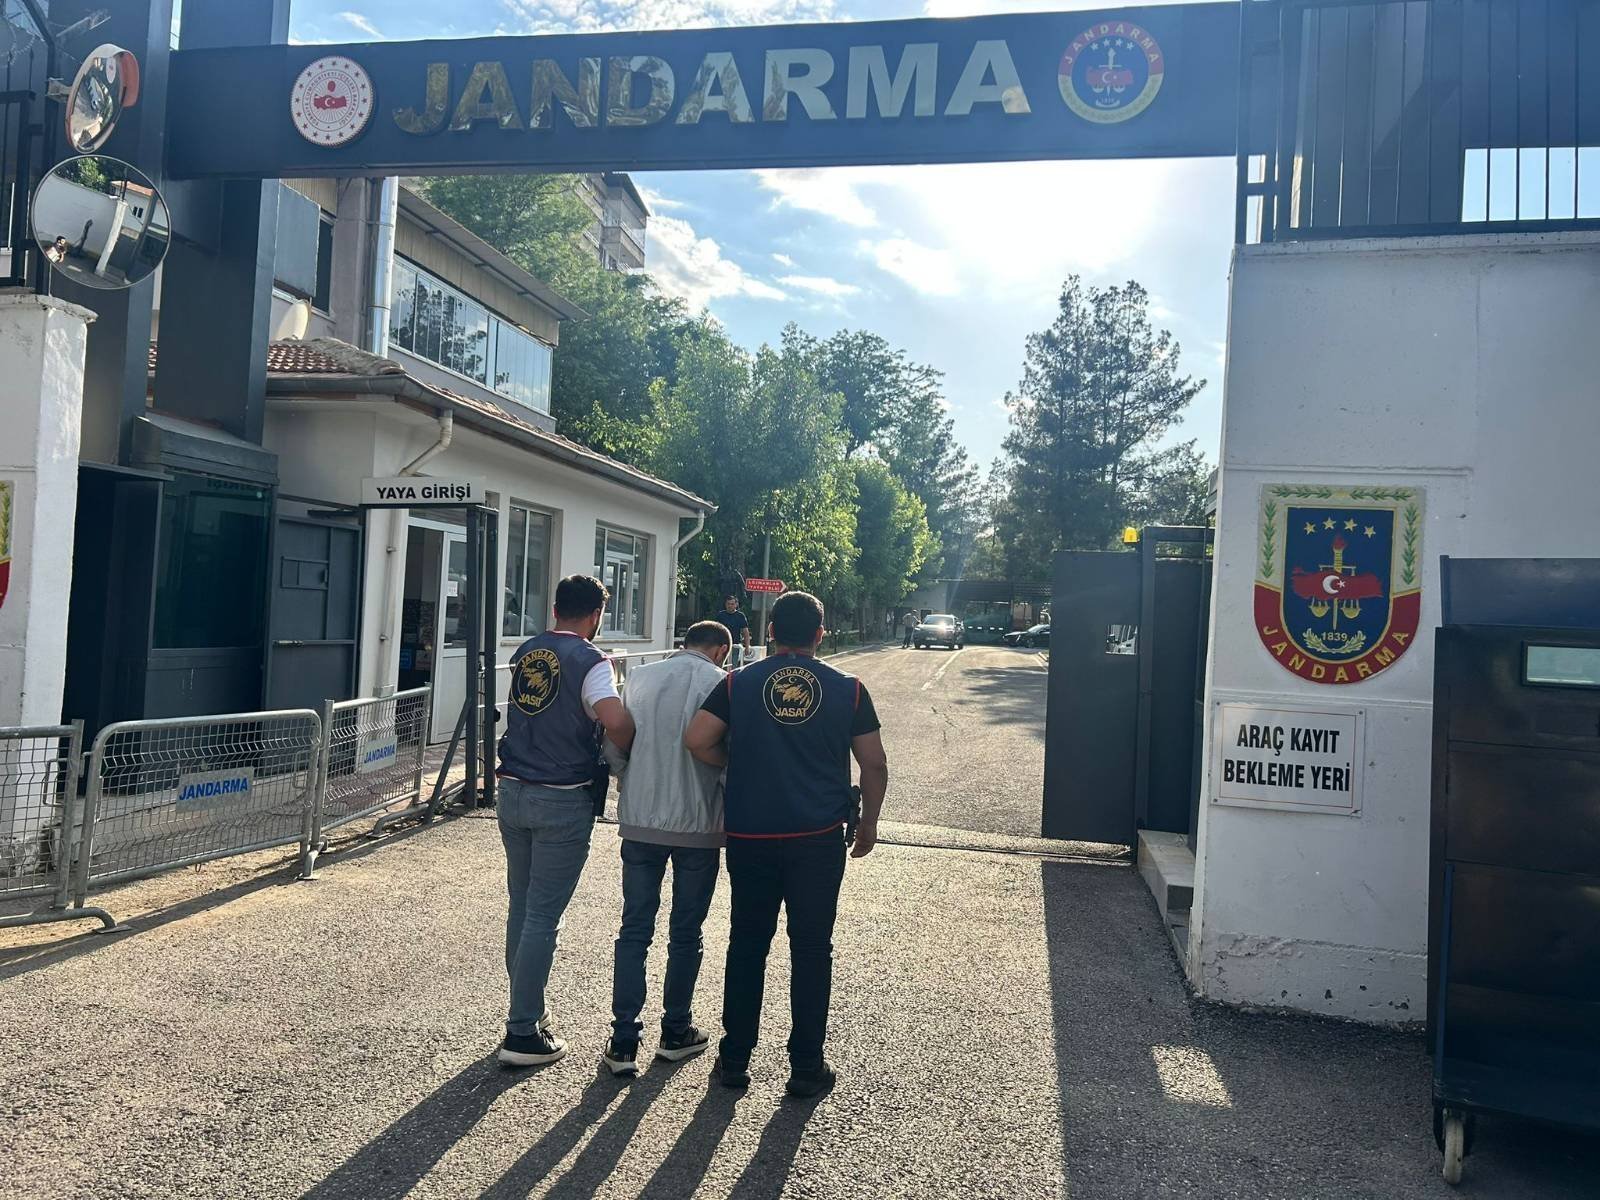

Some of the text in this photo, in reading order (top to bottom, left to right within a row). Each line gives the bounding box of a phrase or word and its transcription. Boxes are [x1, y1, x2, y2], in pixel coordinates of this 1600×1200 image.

[1064, 23, 1160, 65] JANDARMA
[391, 39, 1032, 135] JANDARMA
[376, 482, 471, 501] YAYA GİRİŞİ
[1321, 631, 1348, 642] 1839
[521, 650, 559, 677] JANDARMA
[1262, 624, 1409, 683] JANDARMA
[770, 668, 816, 685] JANDARMA
[775, 707, 807, 717] JASAT
[1236, 724, 1340, 756] ARAÇ KAYIT
[363, 743, 396, 764] JANDARMA
[1223, 759, 1350, 792] BEKLEME YERİ
[178, 777, 249, 801] JANDARMA
